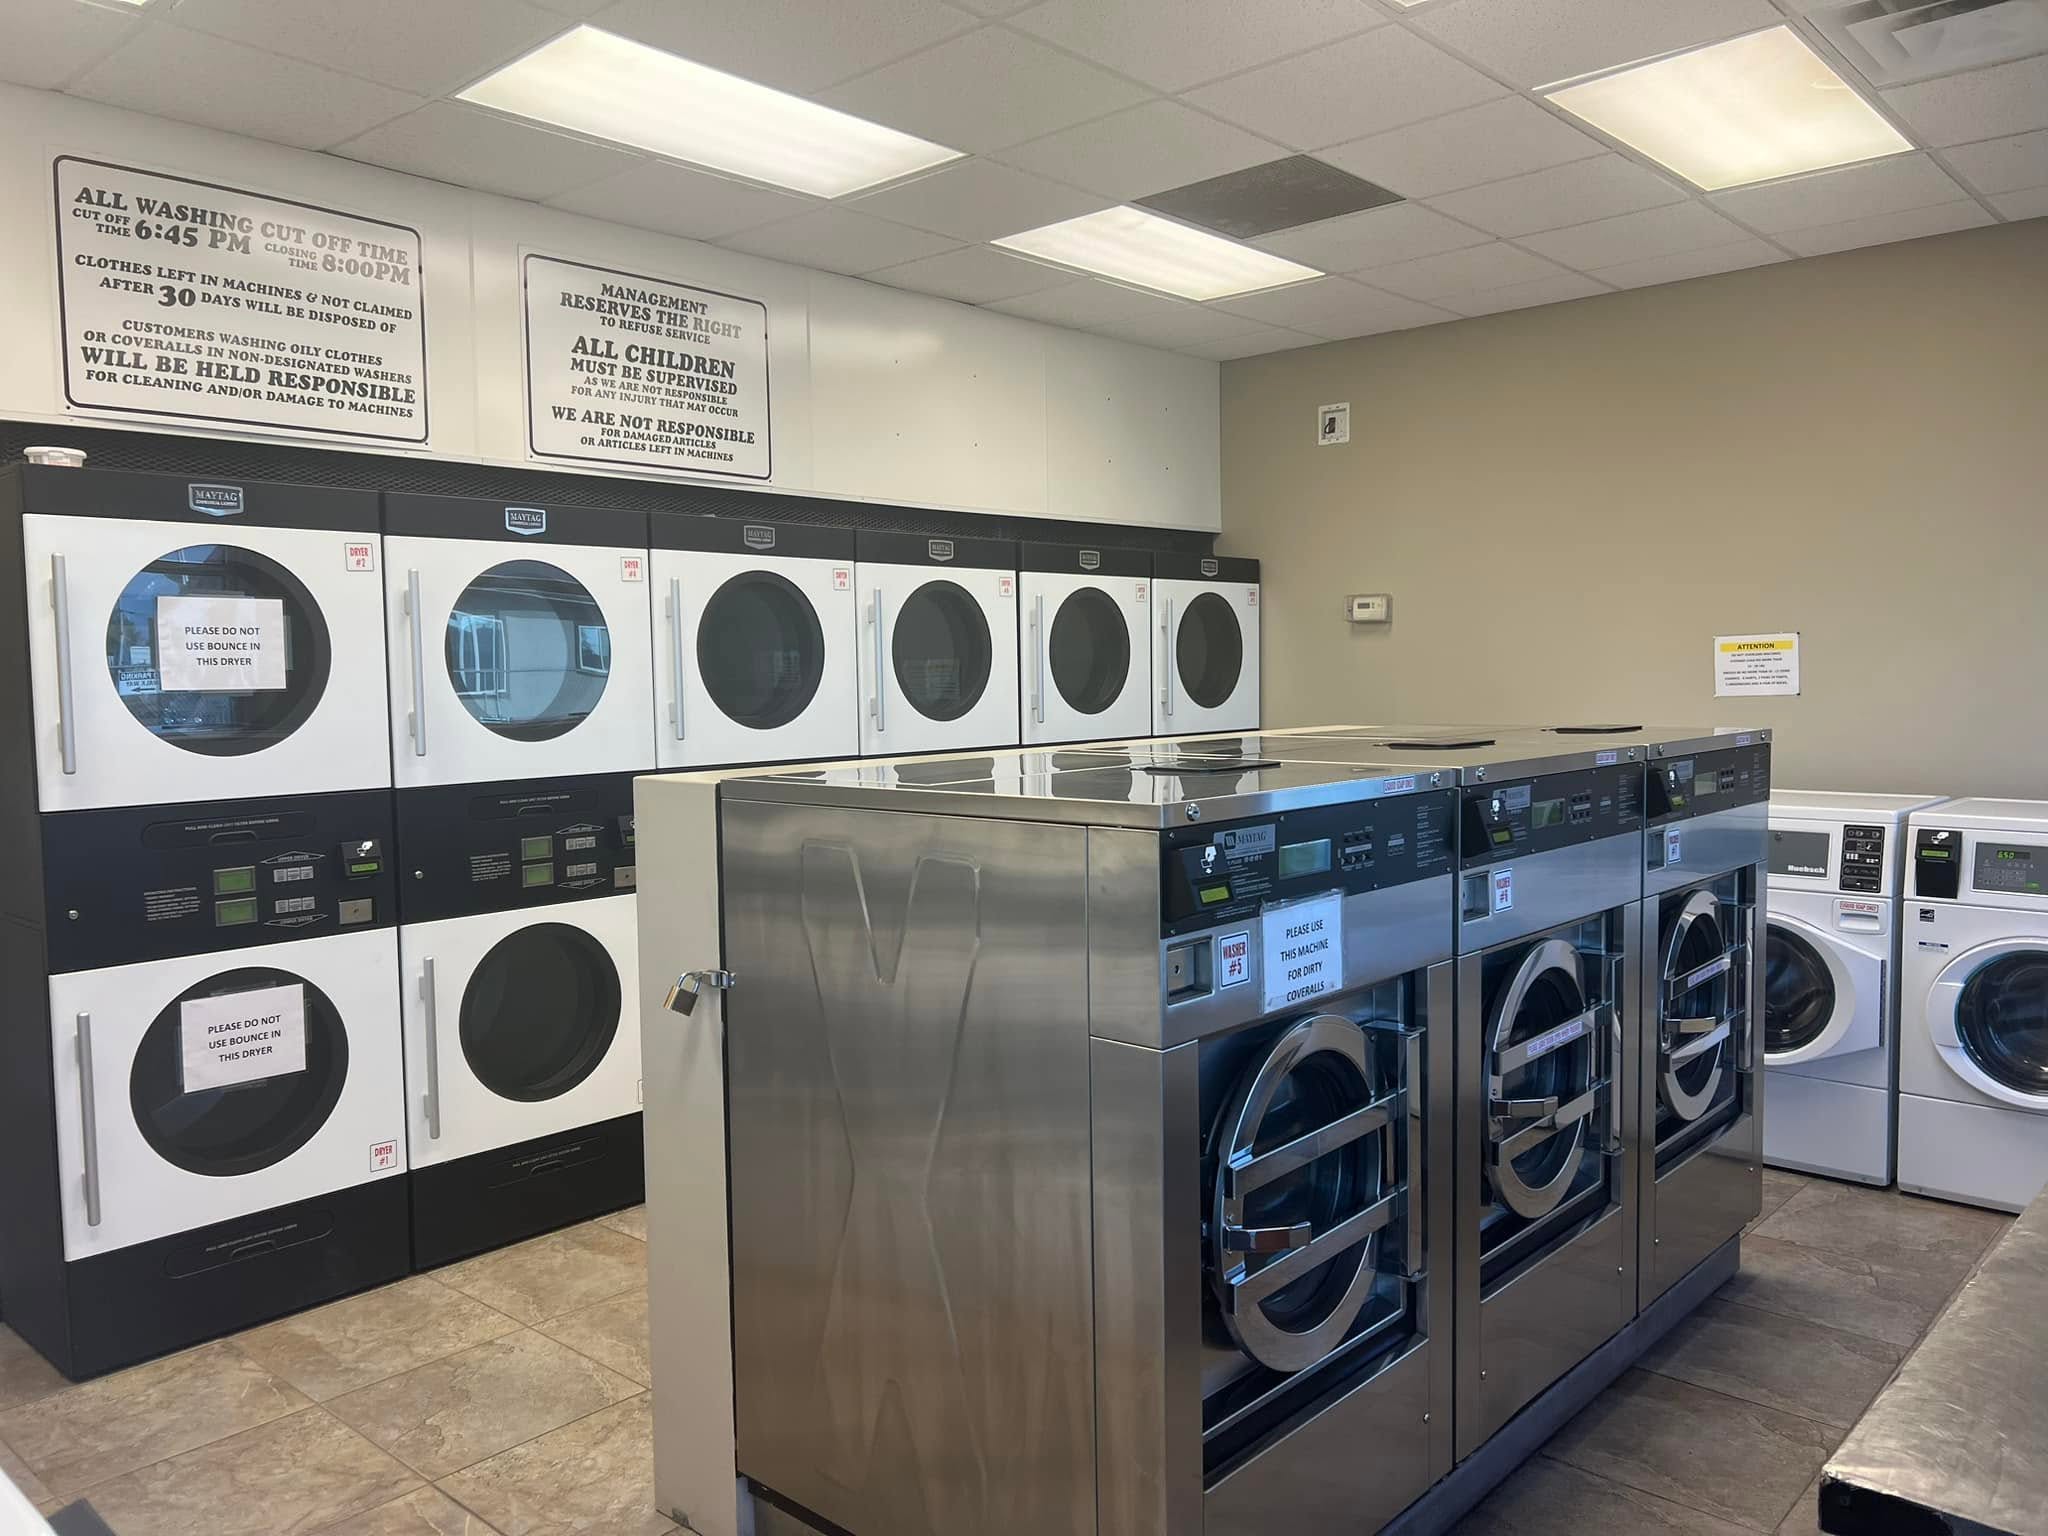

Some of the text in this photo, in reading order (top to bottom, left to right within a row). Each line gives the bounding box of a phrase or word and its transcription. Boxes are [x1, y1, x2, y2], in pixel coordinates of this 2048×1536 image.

[72, 208, 131, 226] CUT OFF
[74, 186, 408, 266] ALL WASHING CUT OFF TIME
[96, 223, 131, 238] TIME
[134, 219, 251, 254] 6:45 PM
[264, 243, 318, 261] CLOSING
[288, 258, 318, 271] TIME
[321, 253, 410, 286] 8:00PM
[75, 254, 412, 320] CLOTHES LEFT IN MACHINES & NOT CLAIMED
[601, 284, 708, 315] MANAGEMENT
[99, 277, 397, 334] AFTER 30 DAYS WILL BE DISPOSED OF
[560, 292, 741, 338] RESERVES THE RIGHT
[122, 319, 382, 366] CUSTOMERS WASHING OILY CLOTHES
[600, 316, 710, 345] TO REFUSE SERVICE
[84, 330, 412, 384] OR COVERALLS IN NON-DESIGNATED WASHERS
[571, 336, 735, 379] ALL CHILDREN
[81, 346, 416, 404] WILL BE HELD RESPONSIBLE
[570, 358, 738, 395] MUST BE SUPERVISED
[86, 369, 413, 418] FOR CLEANING AND/OR DAMAGE TO MACHINES
[571, 386, 739, 417] FOR ANY INJURY THAT MAY OCCUR
[584, 377, 728, 405] AS WE ARE NOT RESPONSIBLE
[552, 406, 755, 444] WE ARE NOT RESPONSIBLE
[580, 436, 734, 462] OR ARTICLES LEFT IN MACHINES
[601, 428, 716, 449] FOR DAMAGED ARTICLES
[195, 490, 238, 501] MAYTAG
[1737, 642, 1775, 650] ATTENTION
[1286, 920, 1323, 938] PLEASE USE
[1223, 942, 1246, 959] WASHER
[1280, 939, 1329, 962] THIS MACHINE
[1228, 960, 1242, 976] #5
[1288, 961, 1322, 980] FOR DIRTY
[1287, 982, 1324, 1002] COVERALLS
[208, 1015, 281, 1034] PLEASE DO NOT
[209, 1030, 281, 1049] USE BOUNCE IN
[219, 1046, 273, 1062] THIS DRYER
[375, 1145, 392, 1156] DRYER
